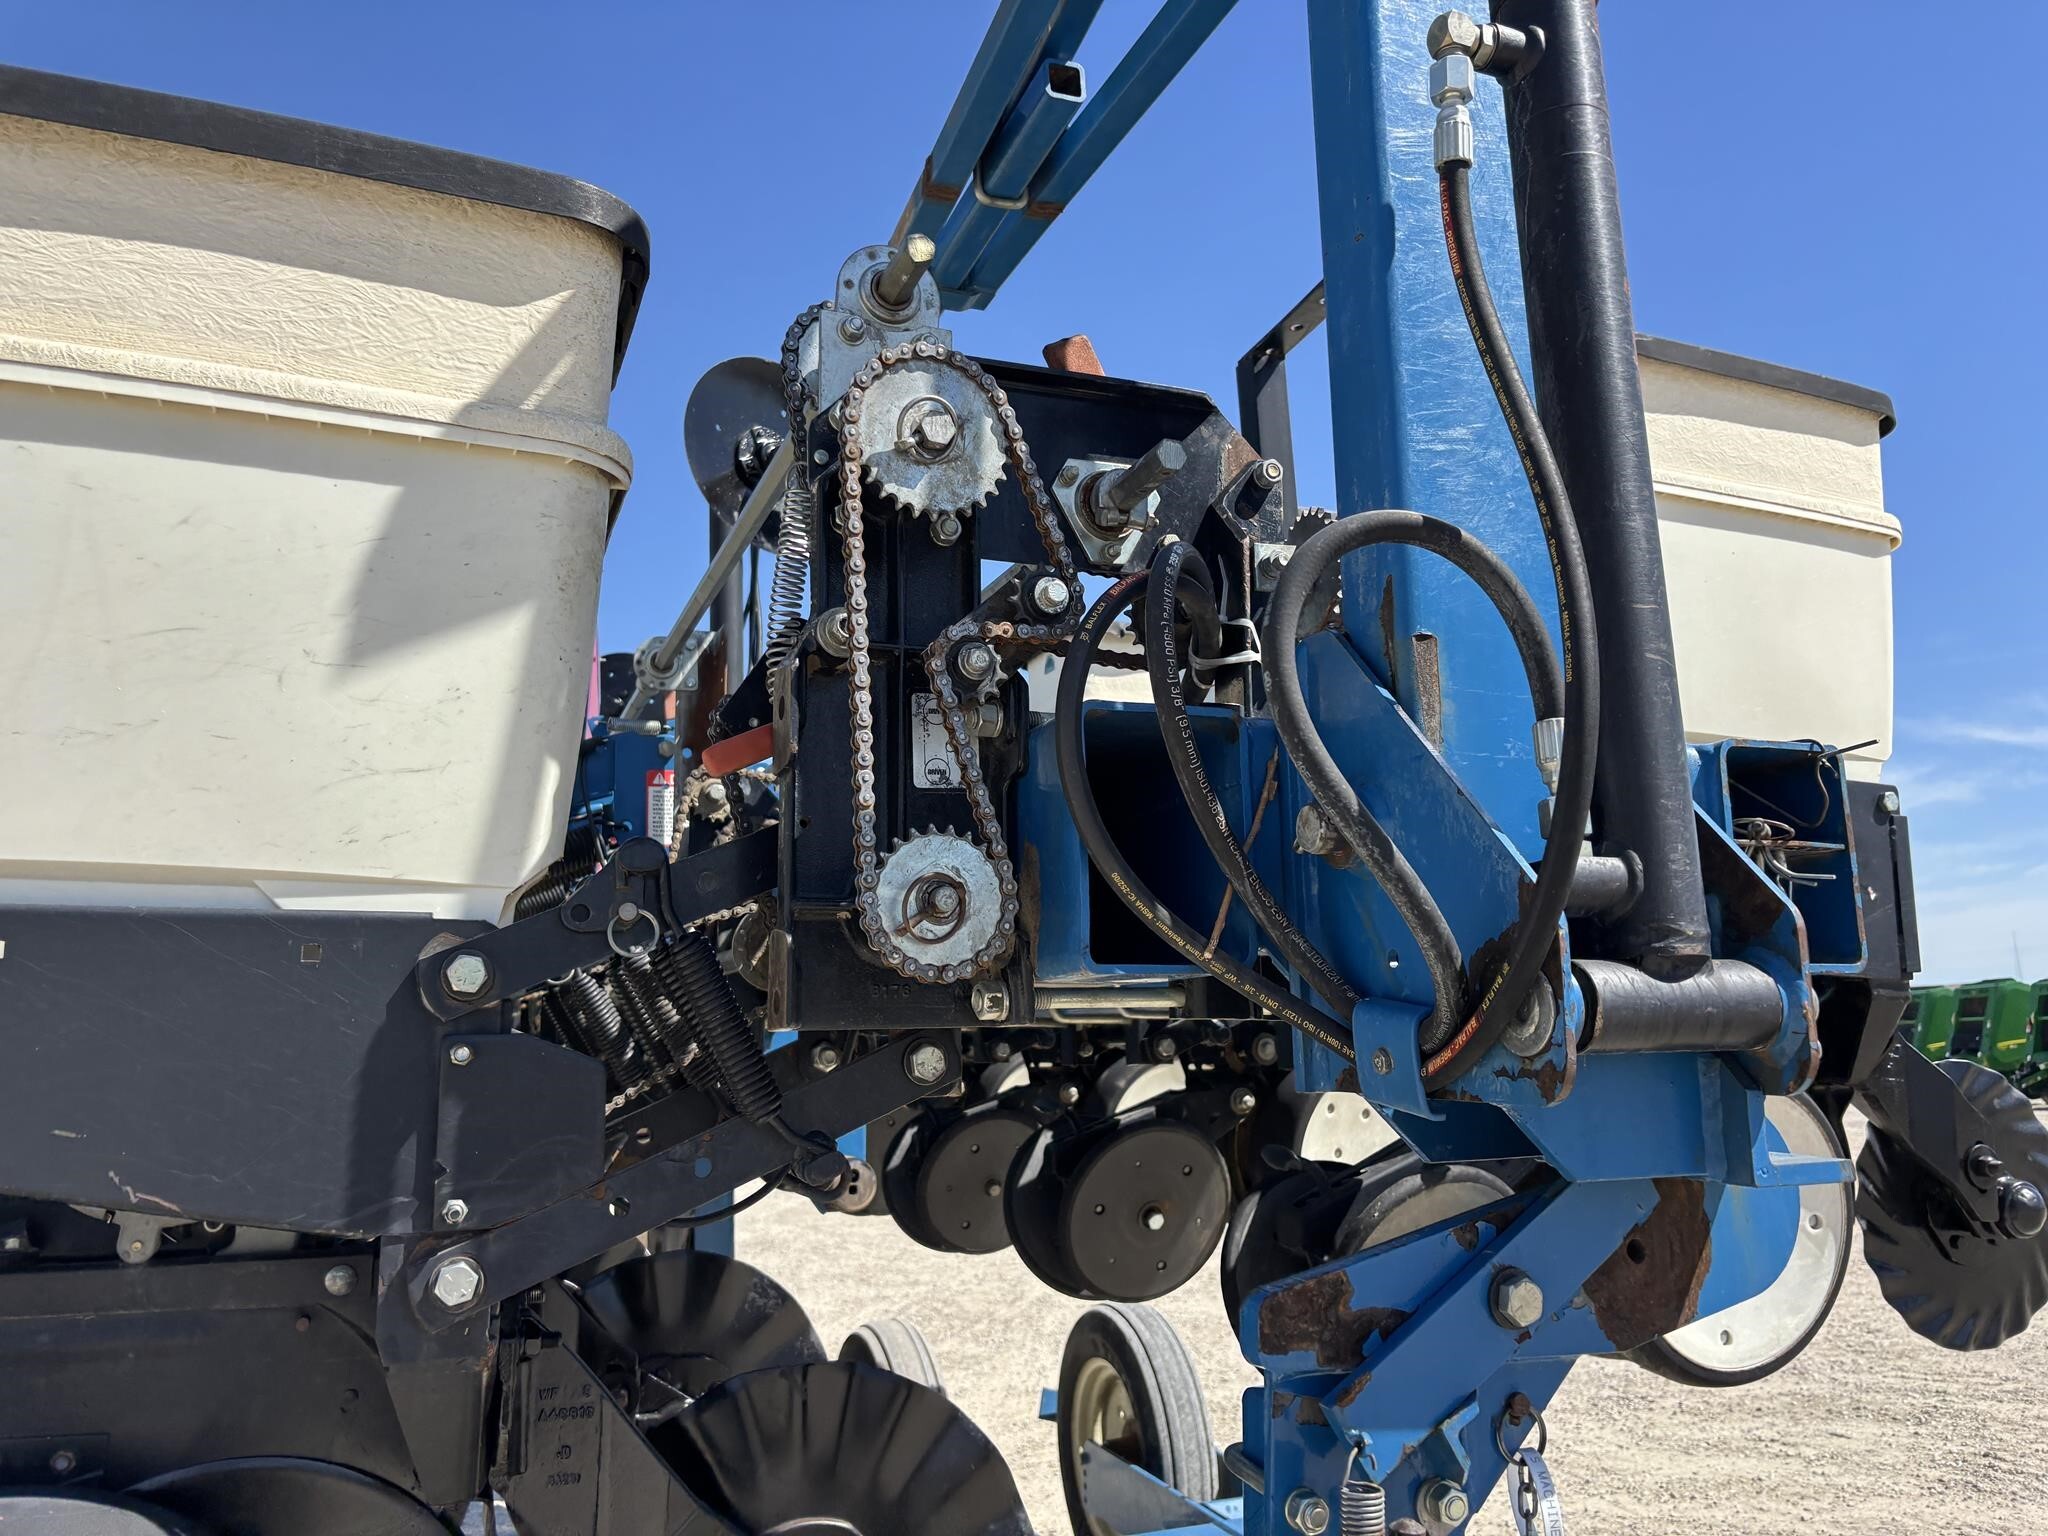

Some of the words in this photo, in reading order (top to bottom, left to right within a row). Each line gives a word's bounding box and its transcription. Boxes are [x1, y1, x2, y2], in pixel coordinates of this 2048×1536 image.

[1446, 231, 1461, 275] PREMIUM
[1457, 278, 1472, 314] EXCEEDS
[1549, 539, 1558, 565] Flame
[1555, 565, 1566, 605] Resistant
[1562, 611, 1571, 640] MSHA
[1084, 601, 1107, 630] BALFLEX
[1110, 576, 1136, 597] BALPAC
[1175, 714, 1192, 737] (9.5
[1185, 740, 1201, 768] mm)
[1135, 899, 1154, 920] MSHA
[1156, 920, 1186, 946] Resistant
[1185, 944, 1205, 961] Flame
[1224, 973, 1238, 983] WP
[1259, 994, 1279, 1009] DN10
[1482, 976, 1504, 1012] BALFLEX
[1282, 1008, 1302, 1024] 11237
[1303, 1020, 1316, 1033] ISO
[1320, 1030, 1342, 1052] 100R16
[1455, 1016, 1478, 1050] BALPAC
[1342, 1046, 1356, 1059] SAE
